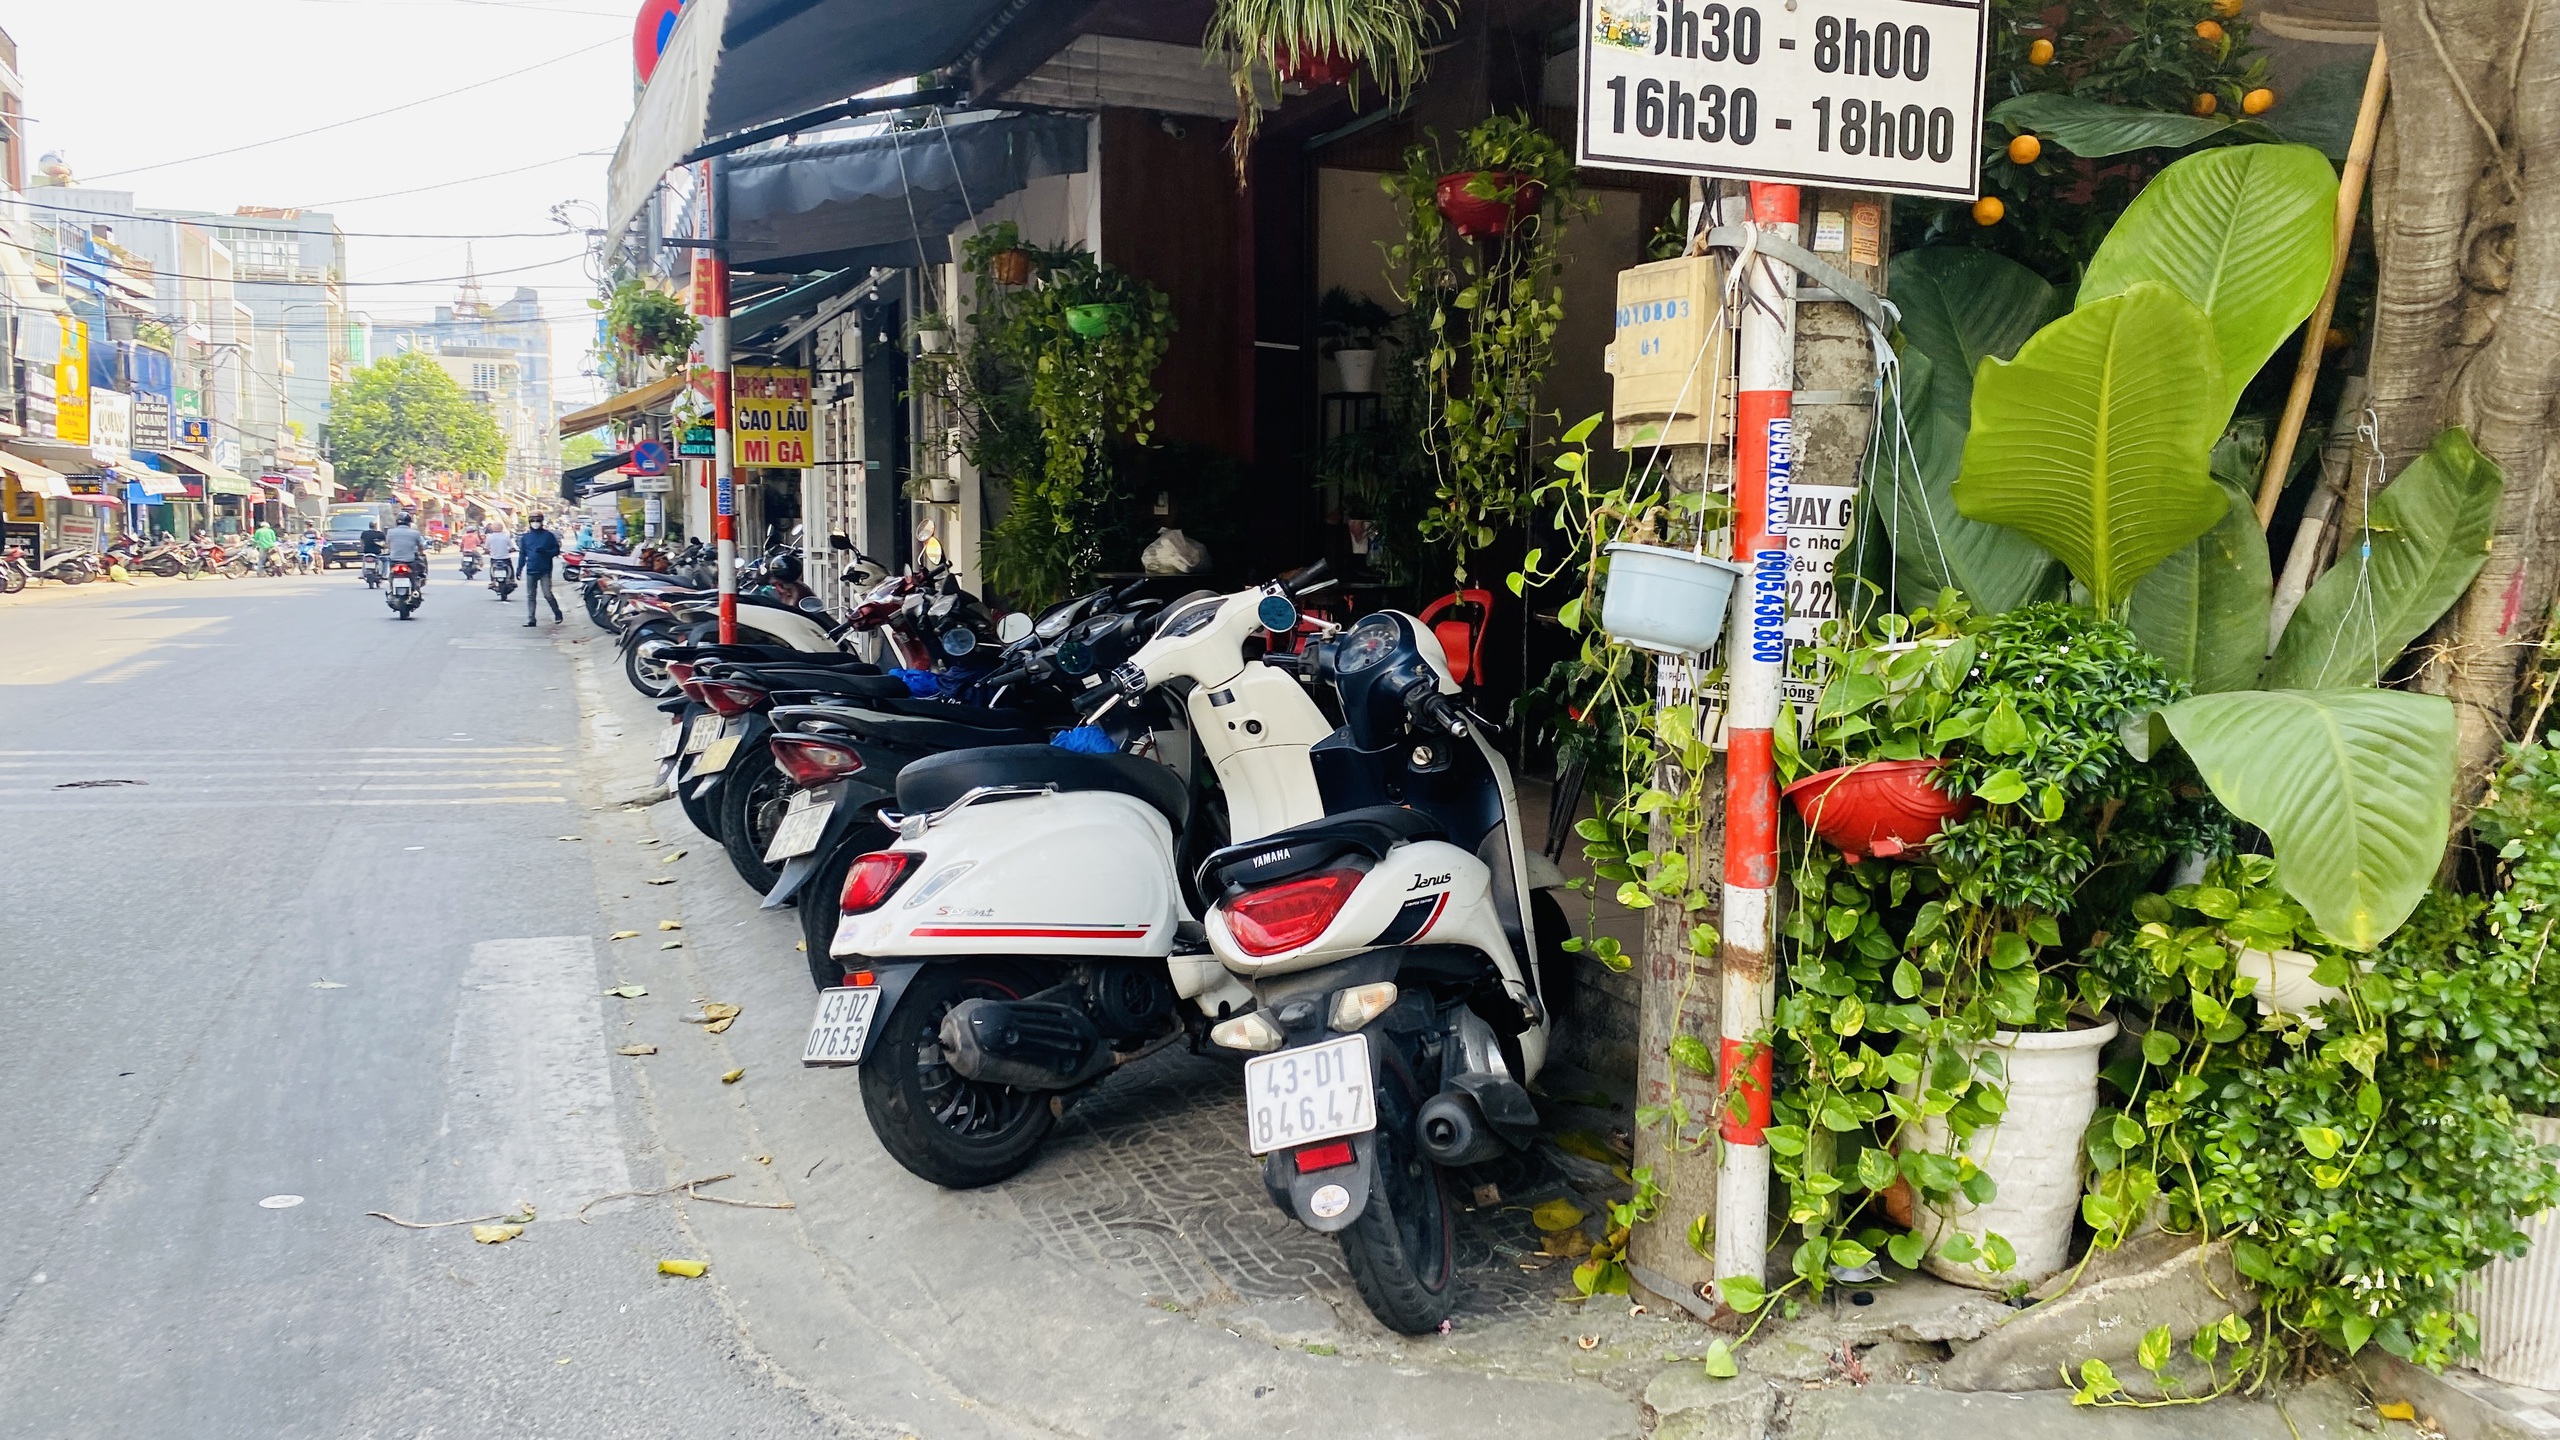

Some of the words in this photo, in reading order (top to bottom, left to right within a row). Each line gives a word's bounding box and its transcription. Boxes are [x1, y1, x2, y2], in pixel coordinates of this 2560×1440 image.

[1814, 15, 1931, 82] 8h00
[1607, 75, 1759, 146] 16h30
[1812, 96, 1955, 164] 18h00
[136, 413, 167, 428] QUANG
[739, 410, 771, 430] CAO
[745, 436, 770, 462] MÌ
[777, 437, 805, 462] GÀ
[1839, 499, 1852, 527] G
[1753, 551, 1787, 662] 0905.436.830
[1252, 848, 1291, 868] YAMAHA
[1406, 872, 1452, 892] Janus
[823, 993, 869, 1024] 43-D2
[807, 1025, 864, 1057] 076.53
[1267, 1046, 1346, 1098] 43-D1
[1257, 1084, 1364, 1144] 846.47
